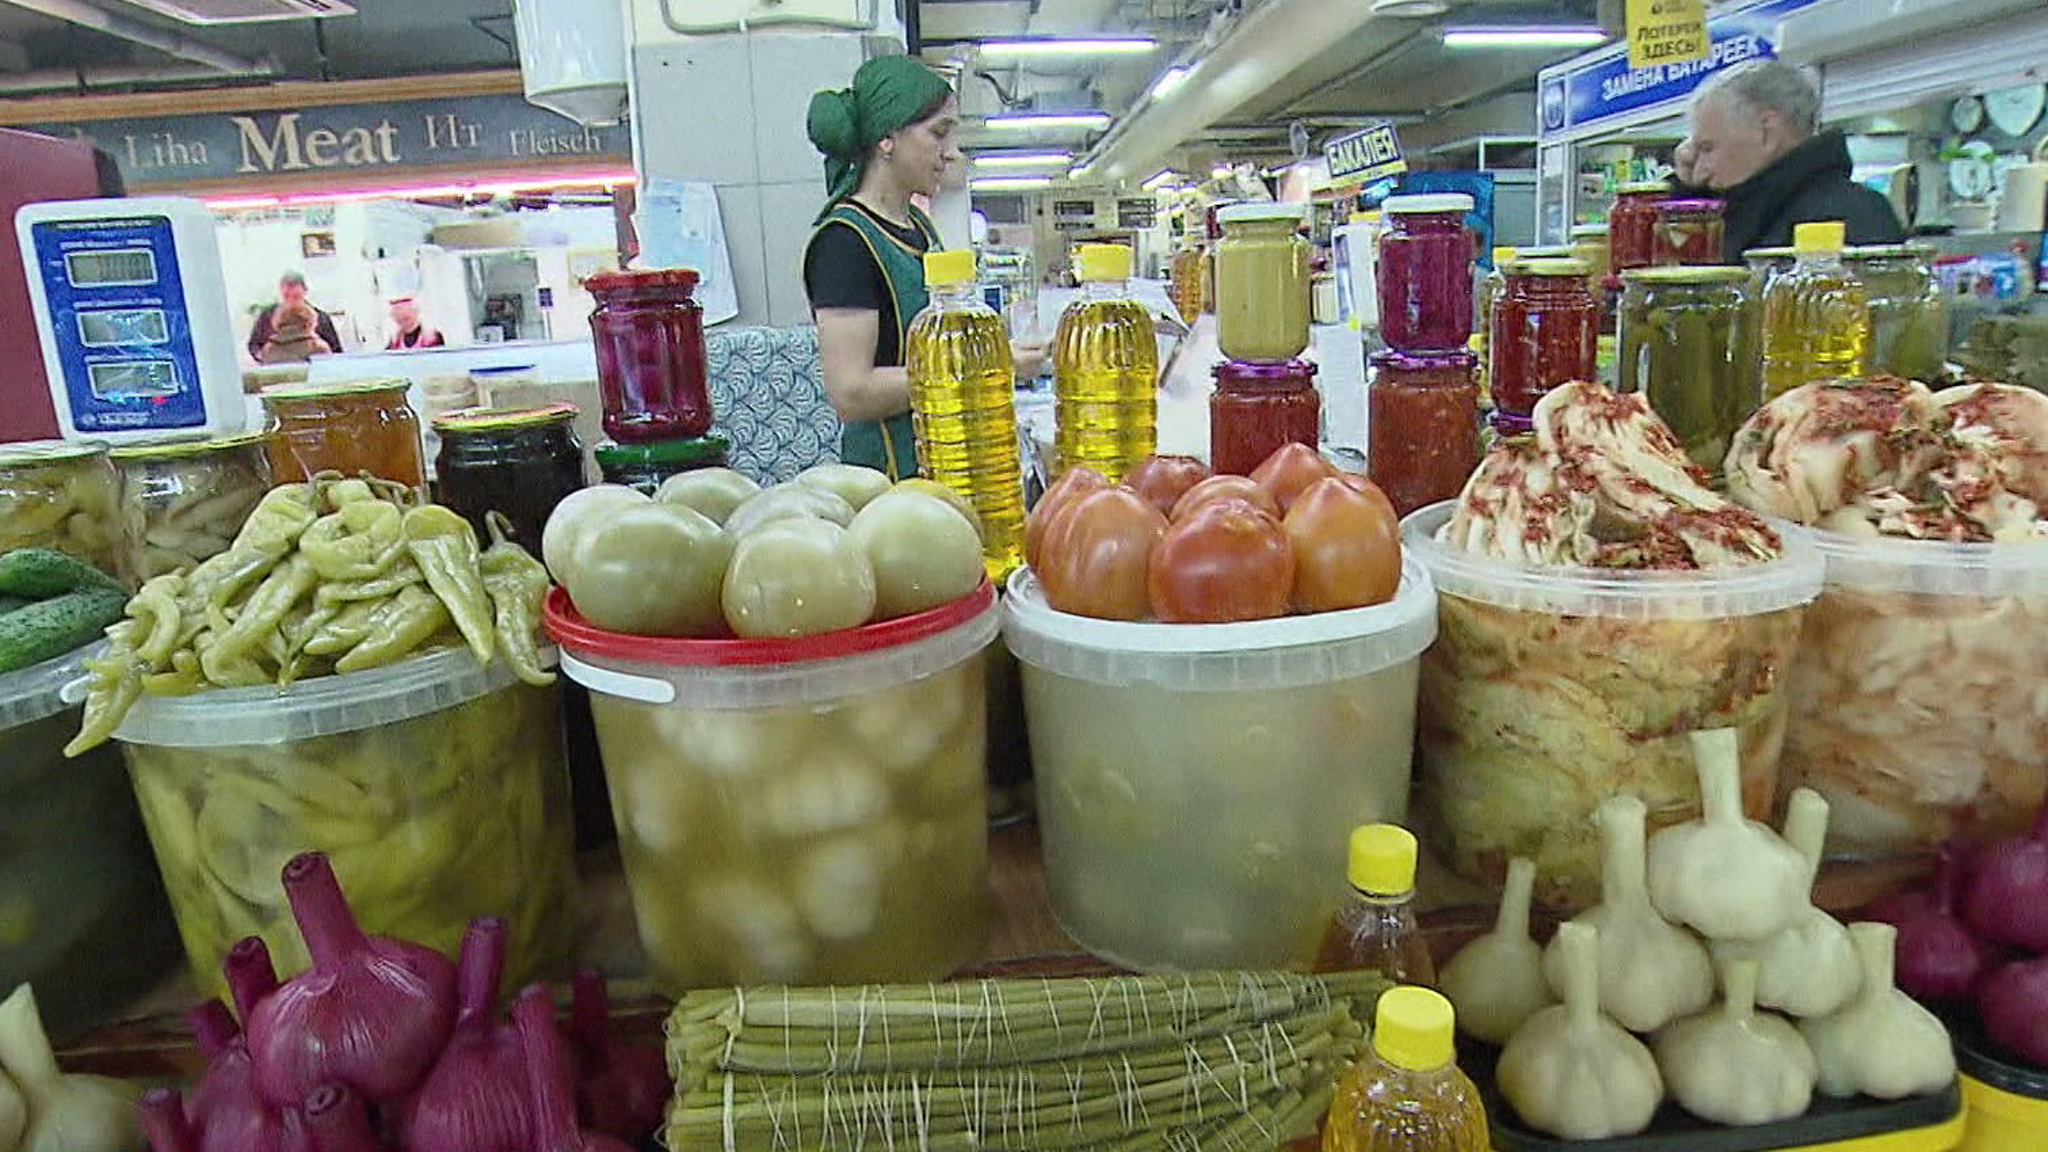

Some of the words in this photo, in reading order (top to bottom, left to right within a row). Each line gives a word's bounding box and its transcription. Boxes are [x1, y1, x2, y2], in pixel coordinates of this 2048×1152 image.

[1602, 66, 1664, 101] ЗАМЕНА
[123, 131, 209, 168] Liha
[231, 113, 402, 173] Meat
[508, 125, 603, 158] Fleisch
[1328, 127, 1397, 175] БАКАЛЕЯ
